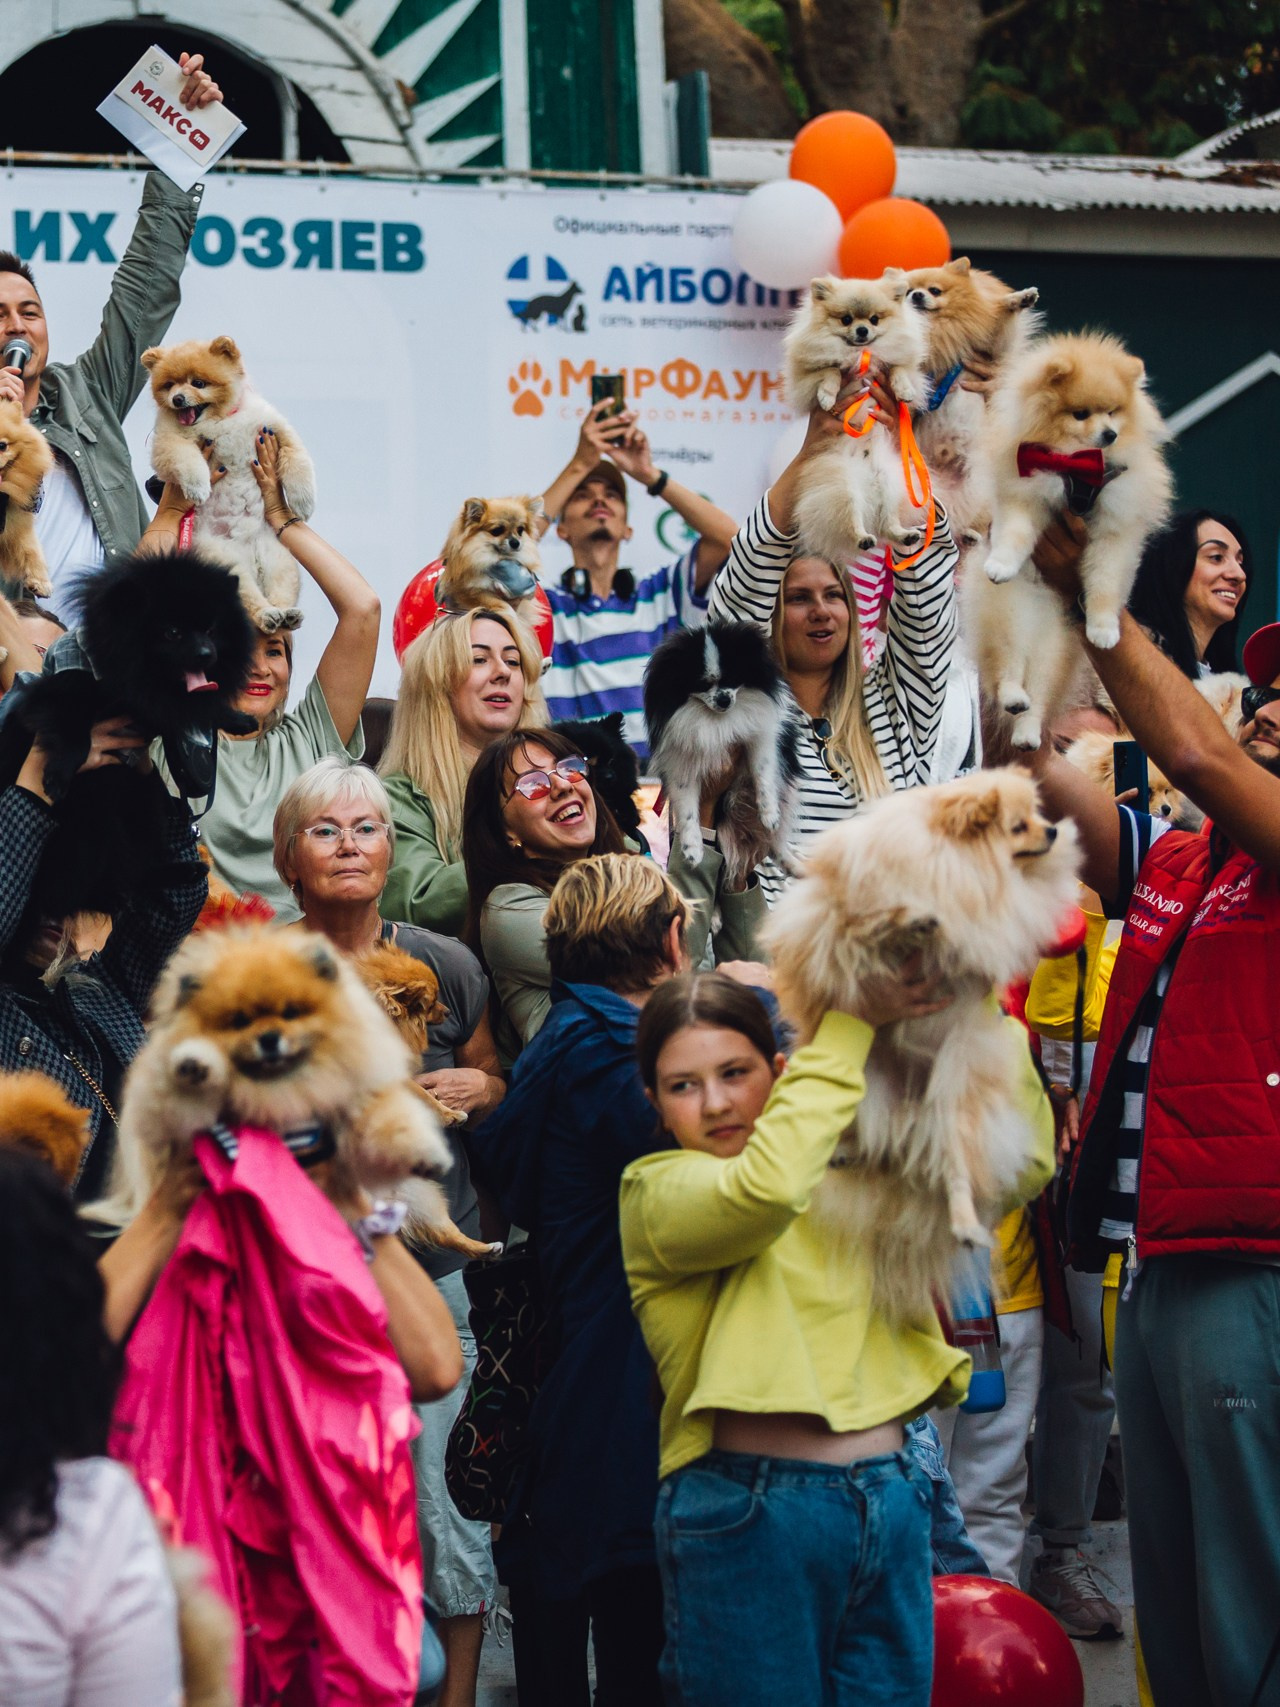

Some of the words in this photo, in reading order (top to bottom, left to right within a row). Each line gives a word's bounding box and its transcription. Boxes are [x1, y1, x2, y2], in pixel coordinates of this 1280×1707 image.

[14, 210, 118, 263] ИХ
[188, 214, 426, 273] ОЗЯЕВ
[687, 222, 733, 239] парт
